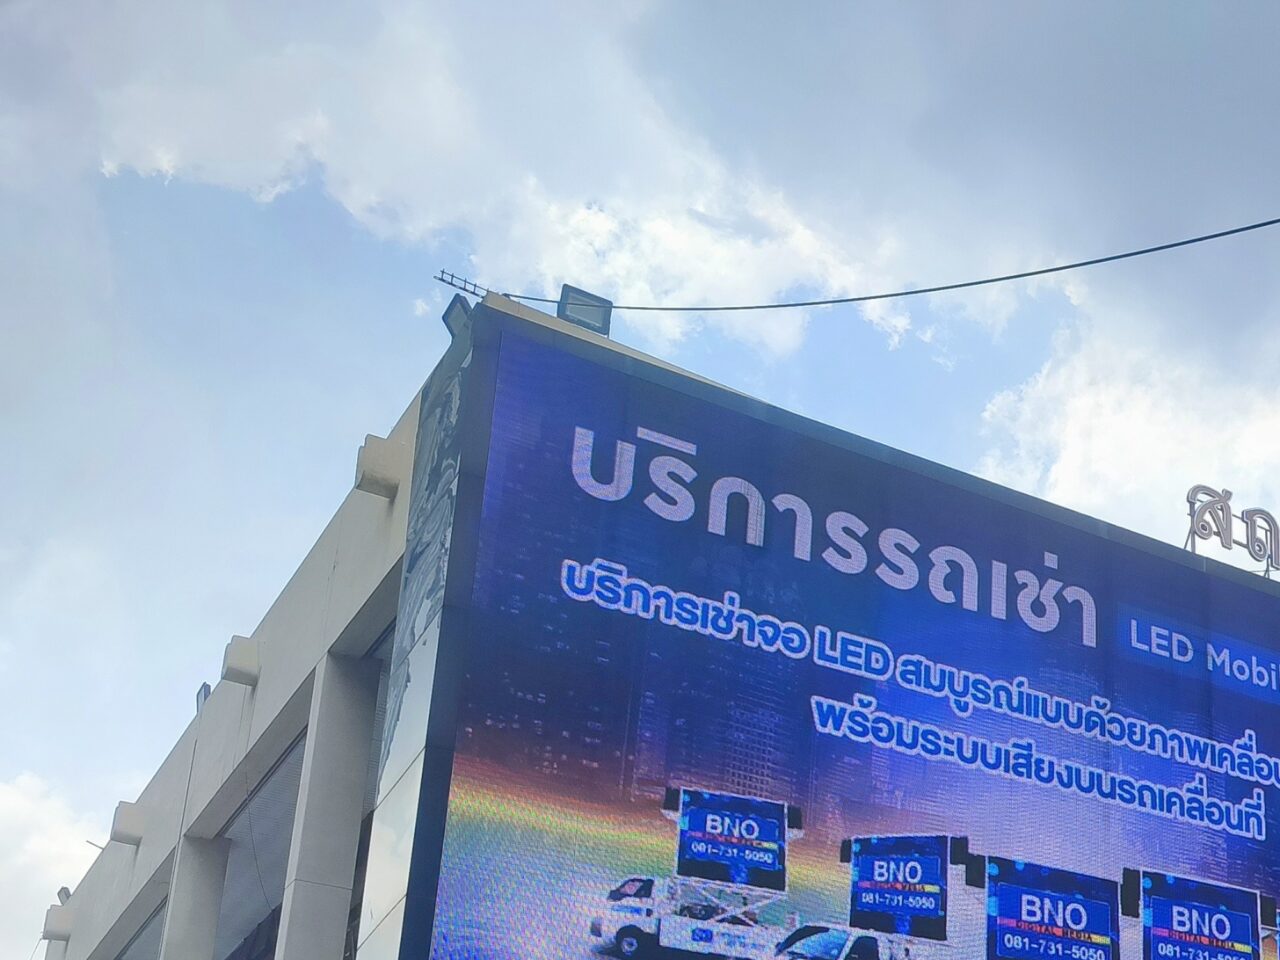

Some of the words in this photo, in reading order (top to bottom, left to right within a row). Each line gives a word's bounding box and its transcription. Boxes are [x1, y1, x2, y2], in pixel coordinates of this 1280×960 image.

[570, 426, 1098, 648] บริการรถเช่า
[561, 558, 808, 661] บริการเช่าจอ
[813, 624, 894, 681] LED
[1130, 619, 1194, 663] LED
[811, 693, 1267, 841] พร้อมระบบเสียงบนรถเคลื่อนที่
[706, 814, 760, 839] BNO
[873, 860, 922, 883] BNO
[1021, 894, 1088, 931] BNO
[1172, 905, 1231, 940] BNO
